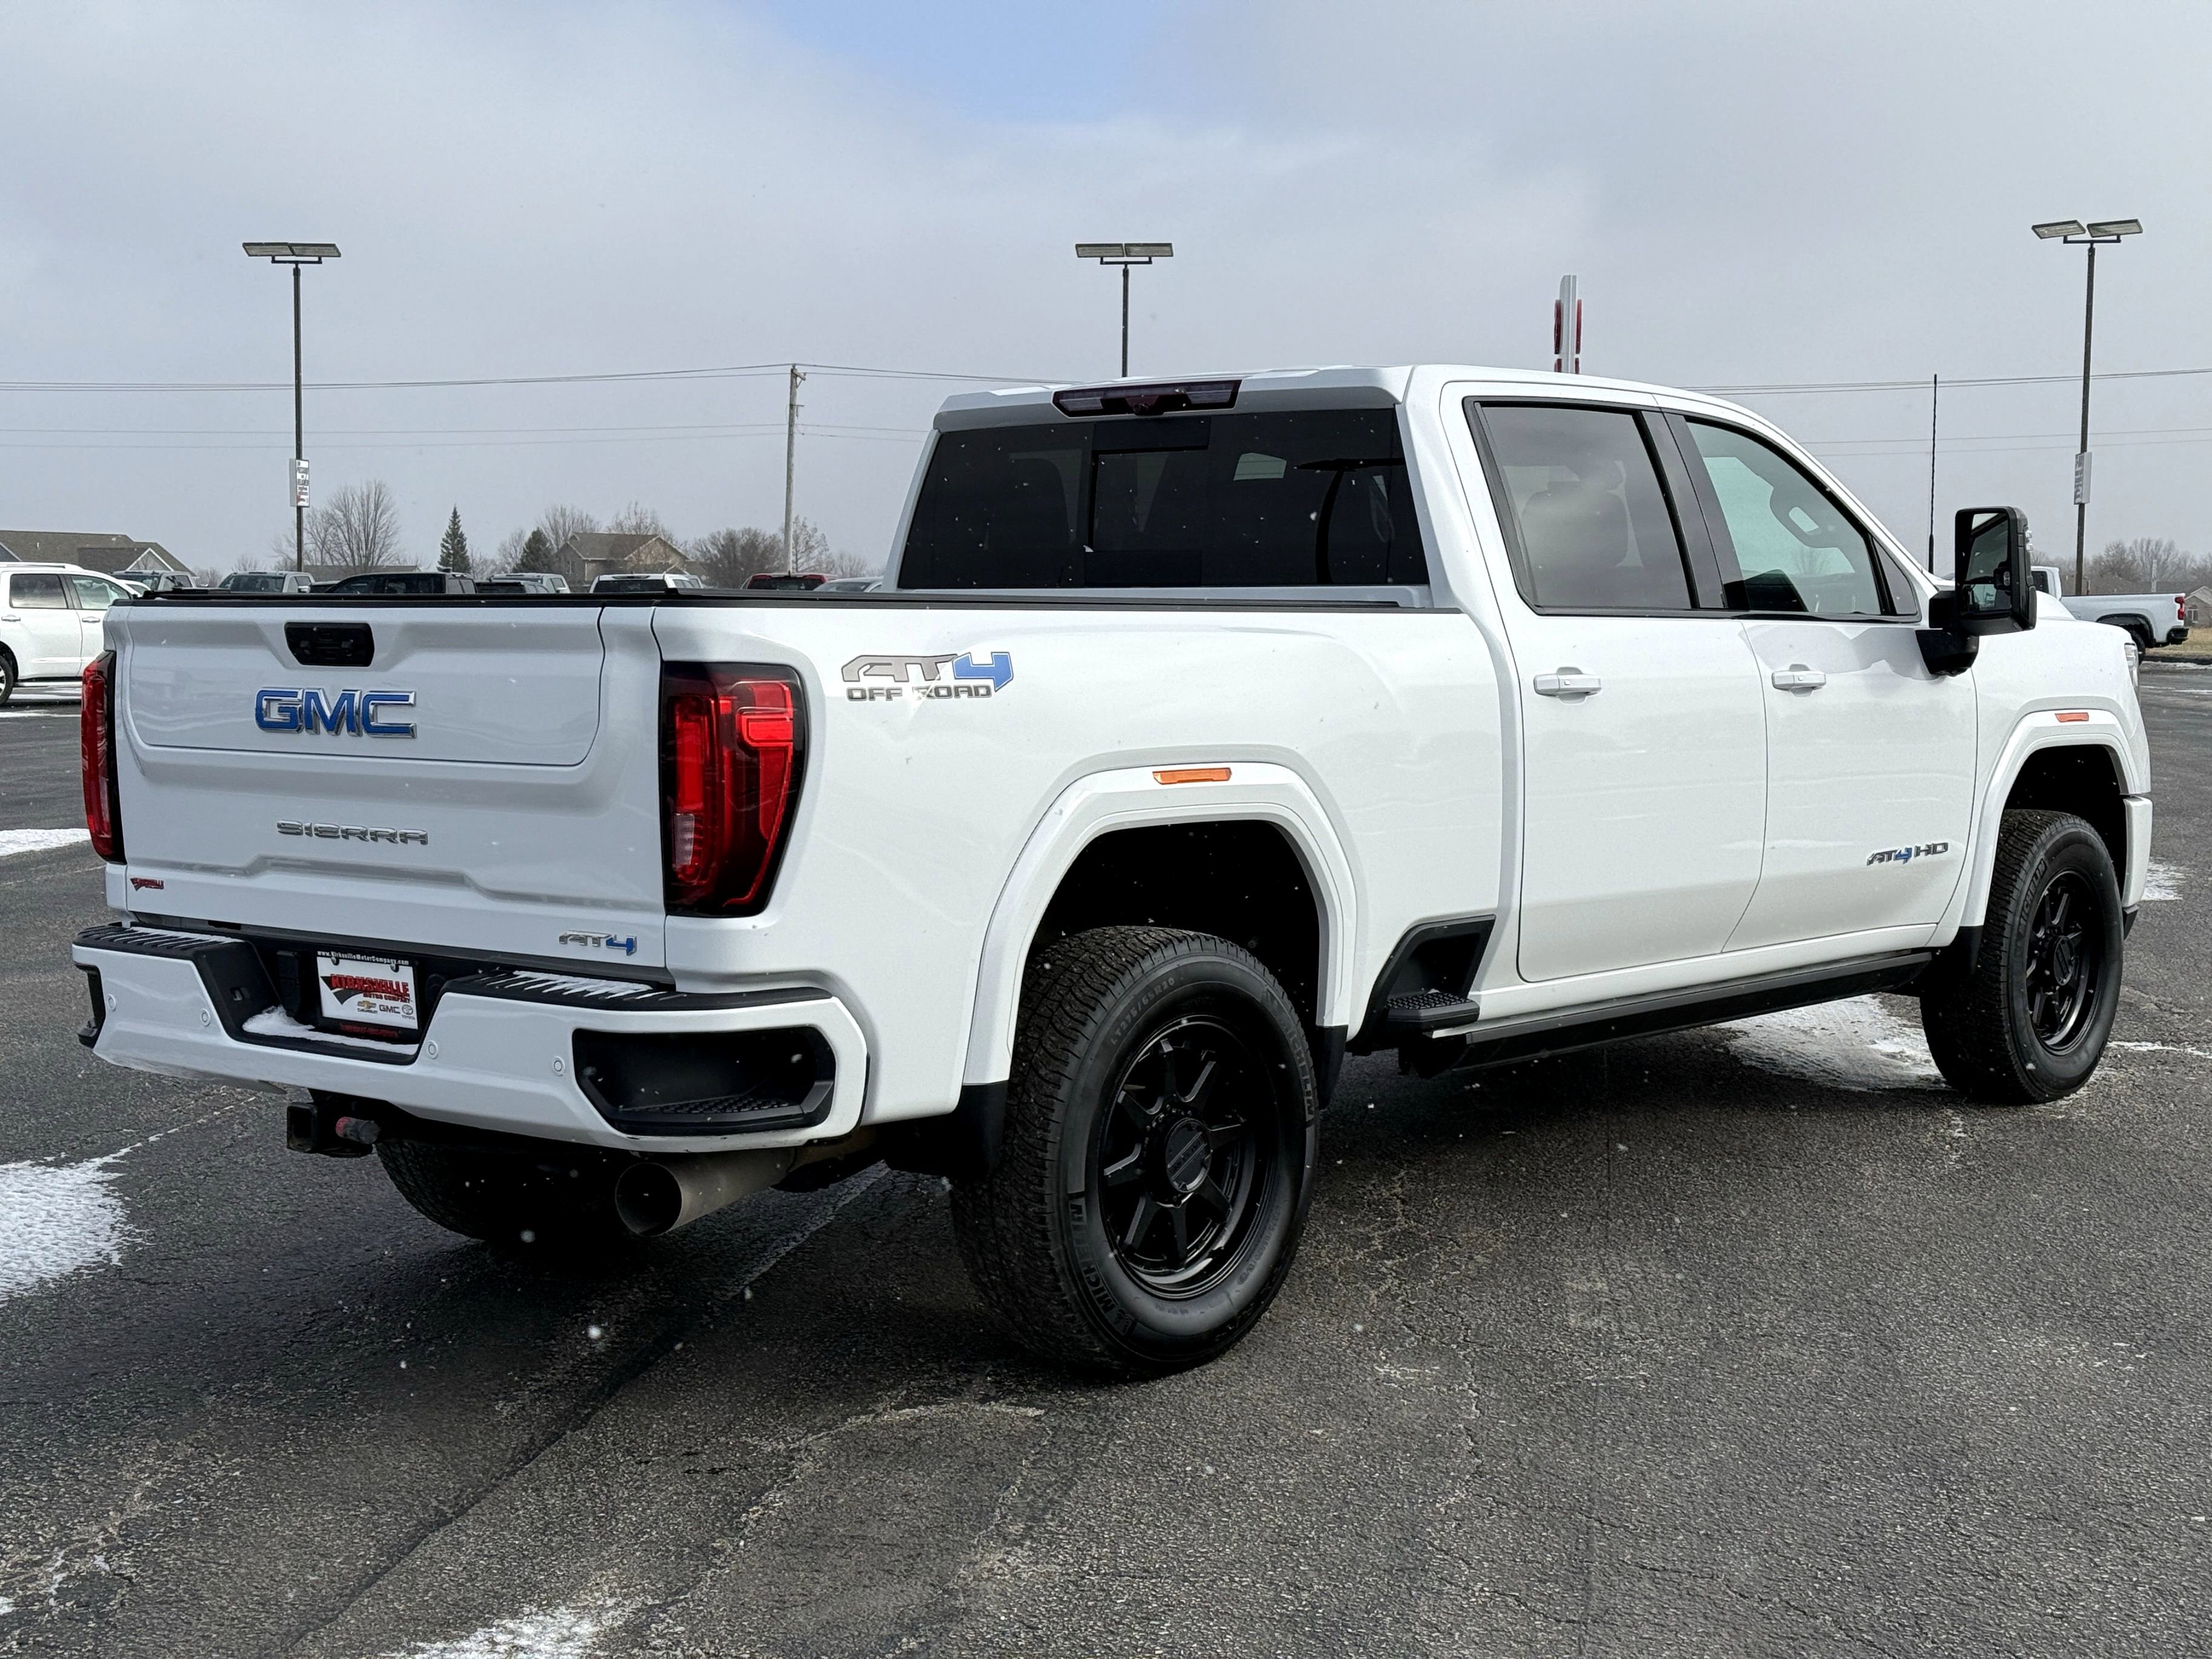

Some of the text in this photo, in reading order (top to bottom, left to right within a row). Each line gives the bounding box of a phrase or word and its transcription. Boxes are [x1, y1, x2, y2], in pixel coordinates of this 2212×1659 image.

[841, 652, 1014, 692] AT4
[846, 684, 992, 701] OFF ROAD
[255, 687, 417, 739] GMC
[277, 819, 428, 845] SIERRA
[1867, 842, 1948, 866] AT4 HD
[559, 930, 637, 956] AT4
[330, 974, 410, 999] KIRKSVILLE
[379, 1005, 400, 1014] GMC
[1070, 1203, 1117, 1313] MICHELIN
